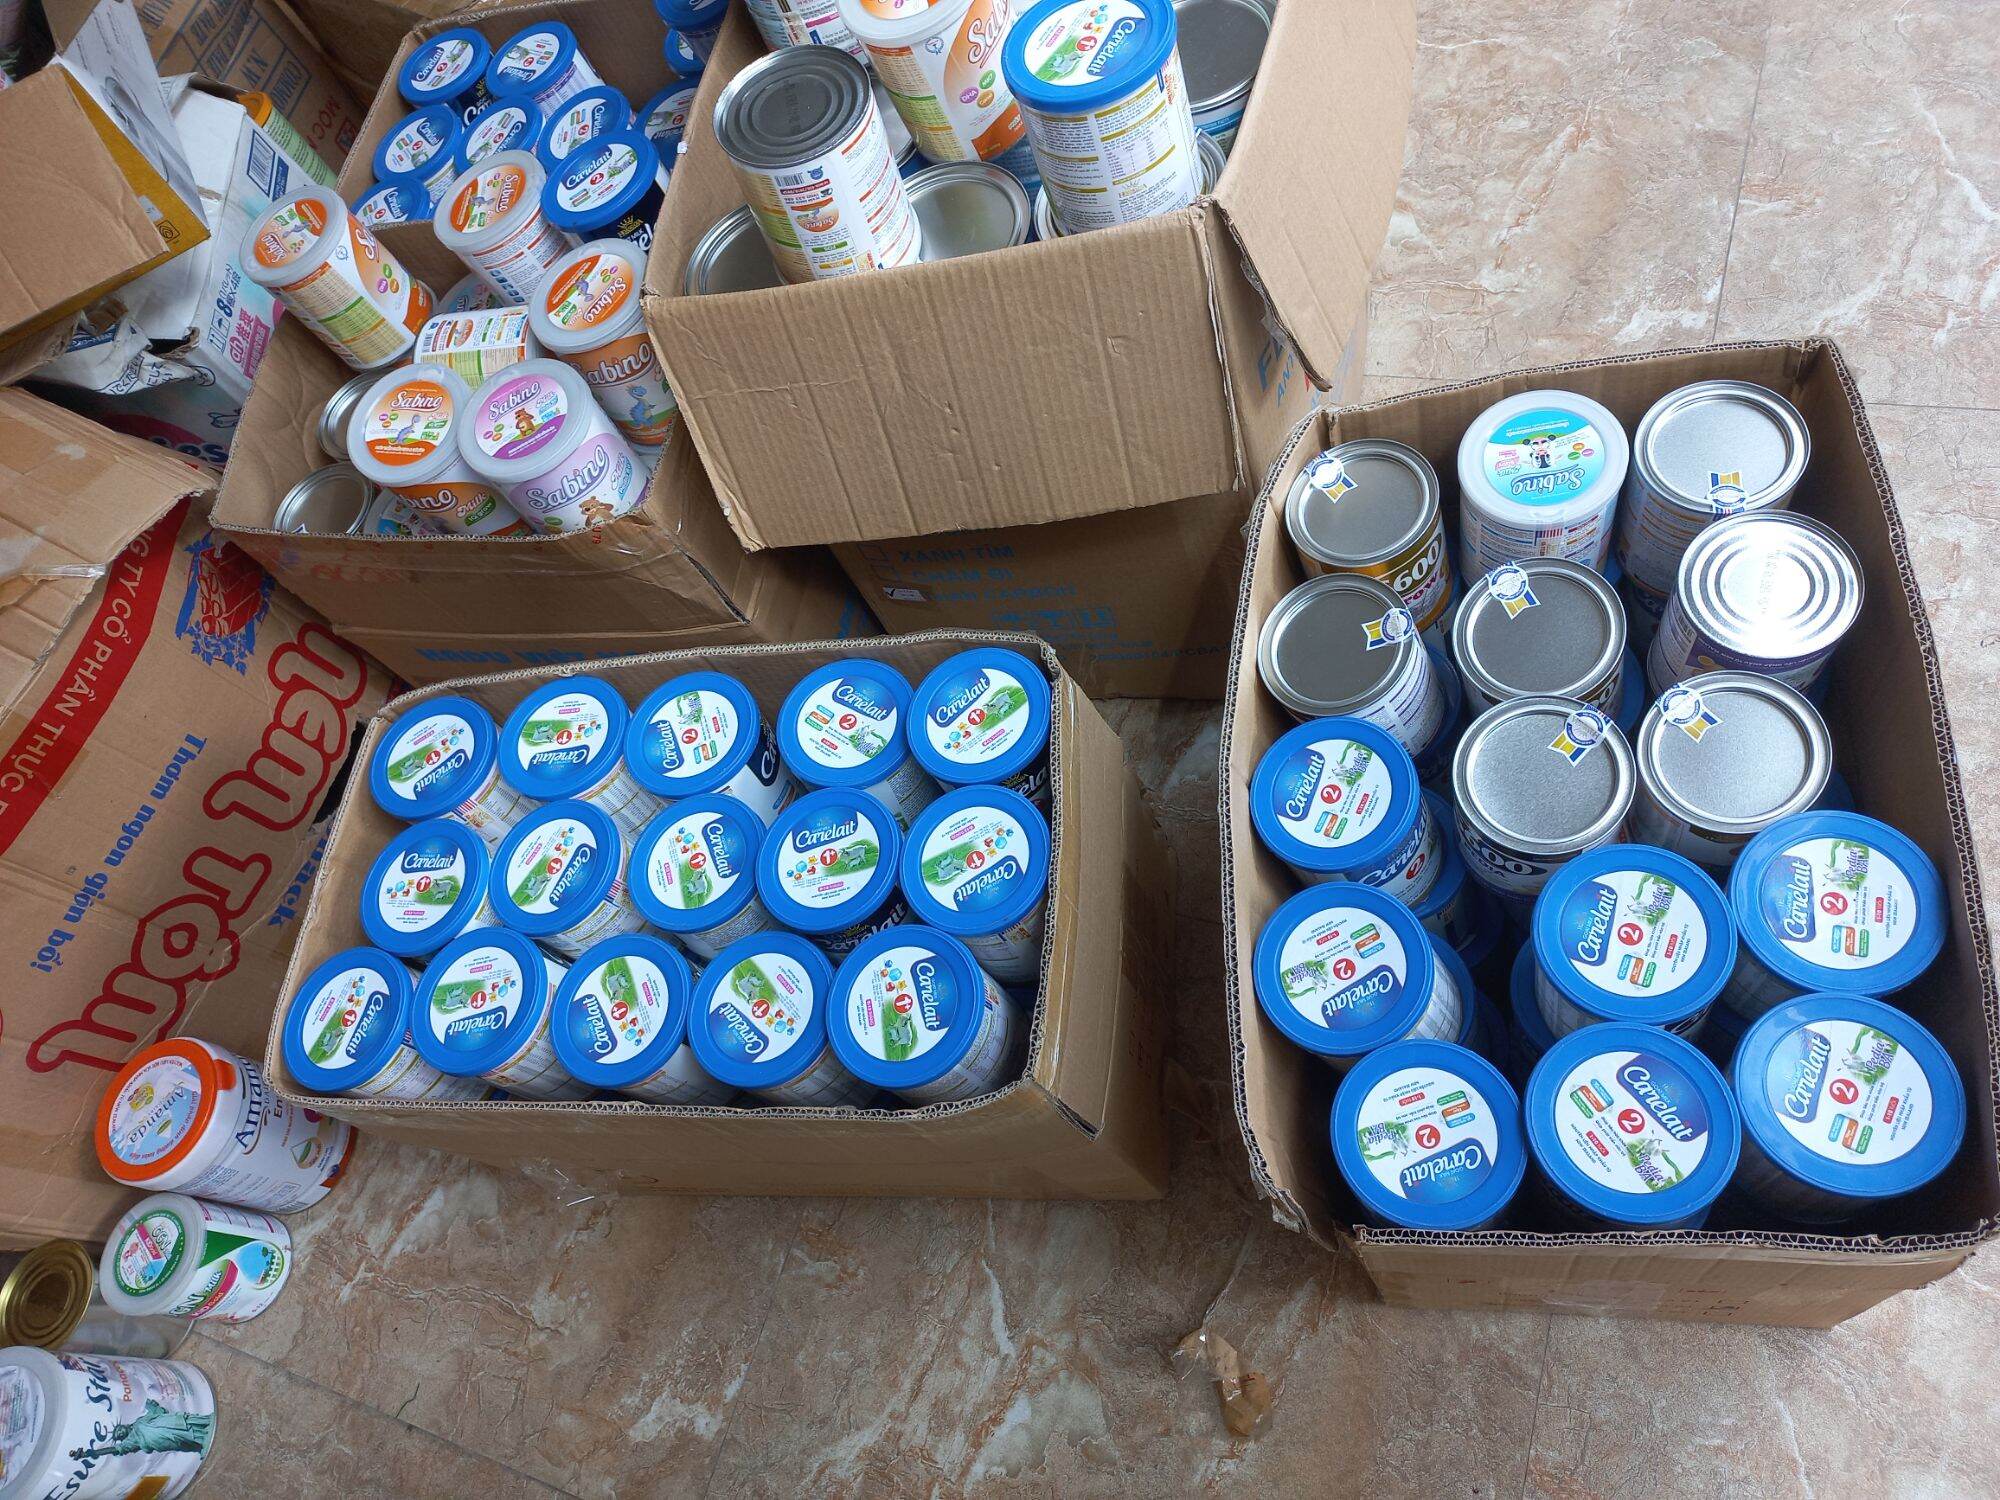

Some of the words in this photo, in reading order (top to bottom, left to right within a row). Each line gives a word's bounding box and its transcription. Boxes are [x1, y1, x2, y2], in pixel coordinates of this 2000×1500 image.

[1087, 17, 1138, 76] Carelait
[565, 149, 613, 190] Carelait
[581, 342, 653, 384] abino
[390, 390, 444, 412] Sabino
[488, 381, 541, 421] Sabino
[527, 444, 609, 511] Sabino
[1510, 465, 1588, 497] Sabino
[121, 564, 145, 600] TY
[1391, 536, 1441, 594] 600
[103, 598, 132, 645] CỔ
[54, 640, 114, 717] PHẦN
[0, 722, 70, 794] THỰC
[150, 733, 208, 800] Thơm
[1284, 752, 1326, 820] Carelait
[1324, 786, 1339, 802] 2
[104, 803, 156, 867] ngon
[1782, 858, 1812, 940] Carelait
[1825, 895, 1845, 914] 2
[1576, 888, 1618, 963] Carelait
[1620, 926, 1641, 944] 2
[1337, 962, 1352, 979] 2
[1322, 971, 1395, 1018] Carelait
[1783, 1034, 1832, 1118] Carelait
[1832, 1083, 1854, 1101] 2
[129, 1079, 185, 1144] Amanda
[1622, 1111, 1640, 1132] 2
[1623, 1065, 1695, 1142] Carelait
[1418, 1128, 1437, 1148] 2
[1403, 1145, 1483, 1188] Carelait
